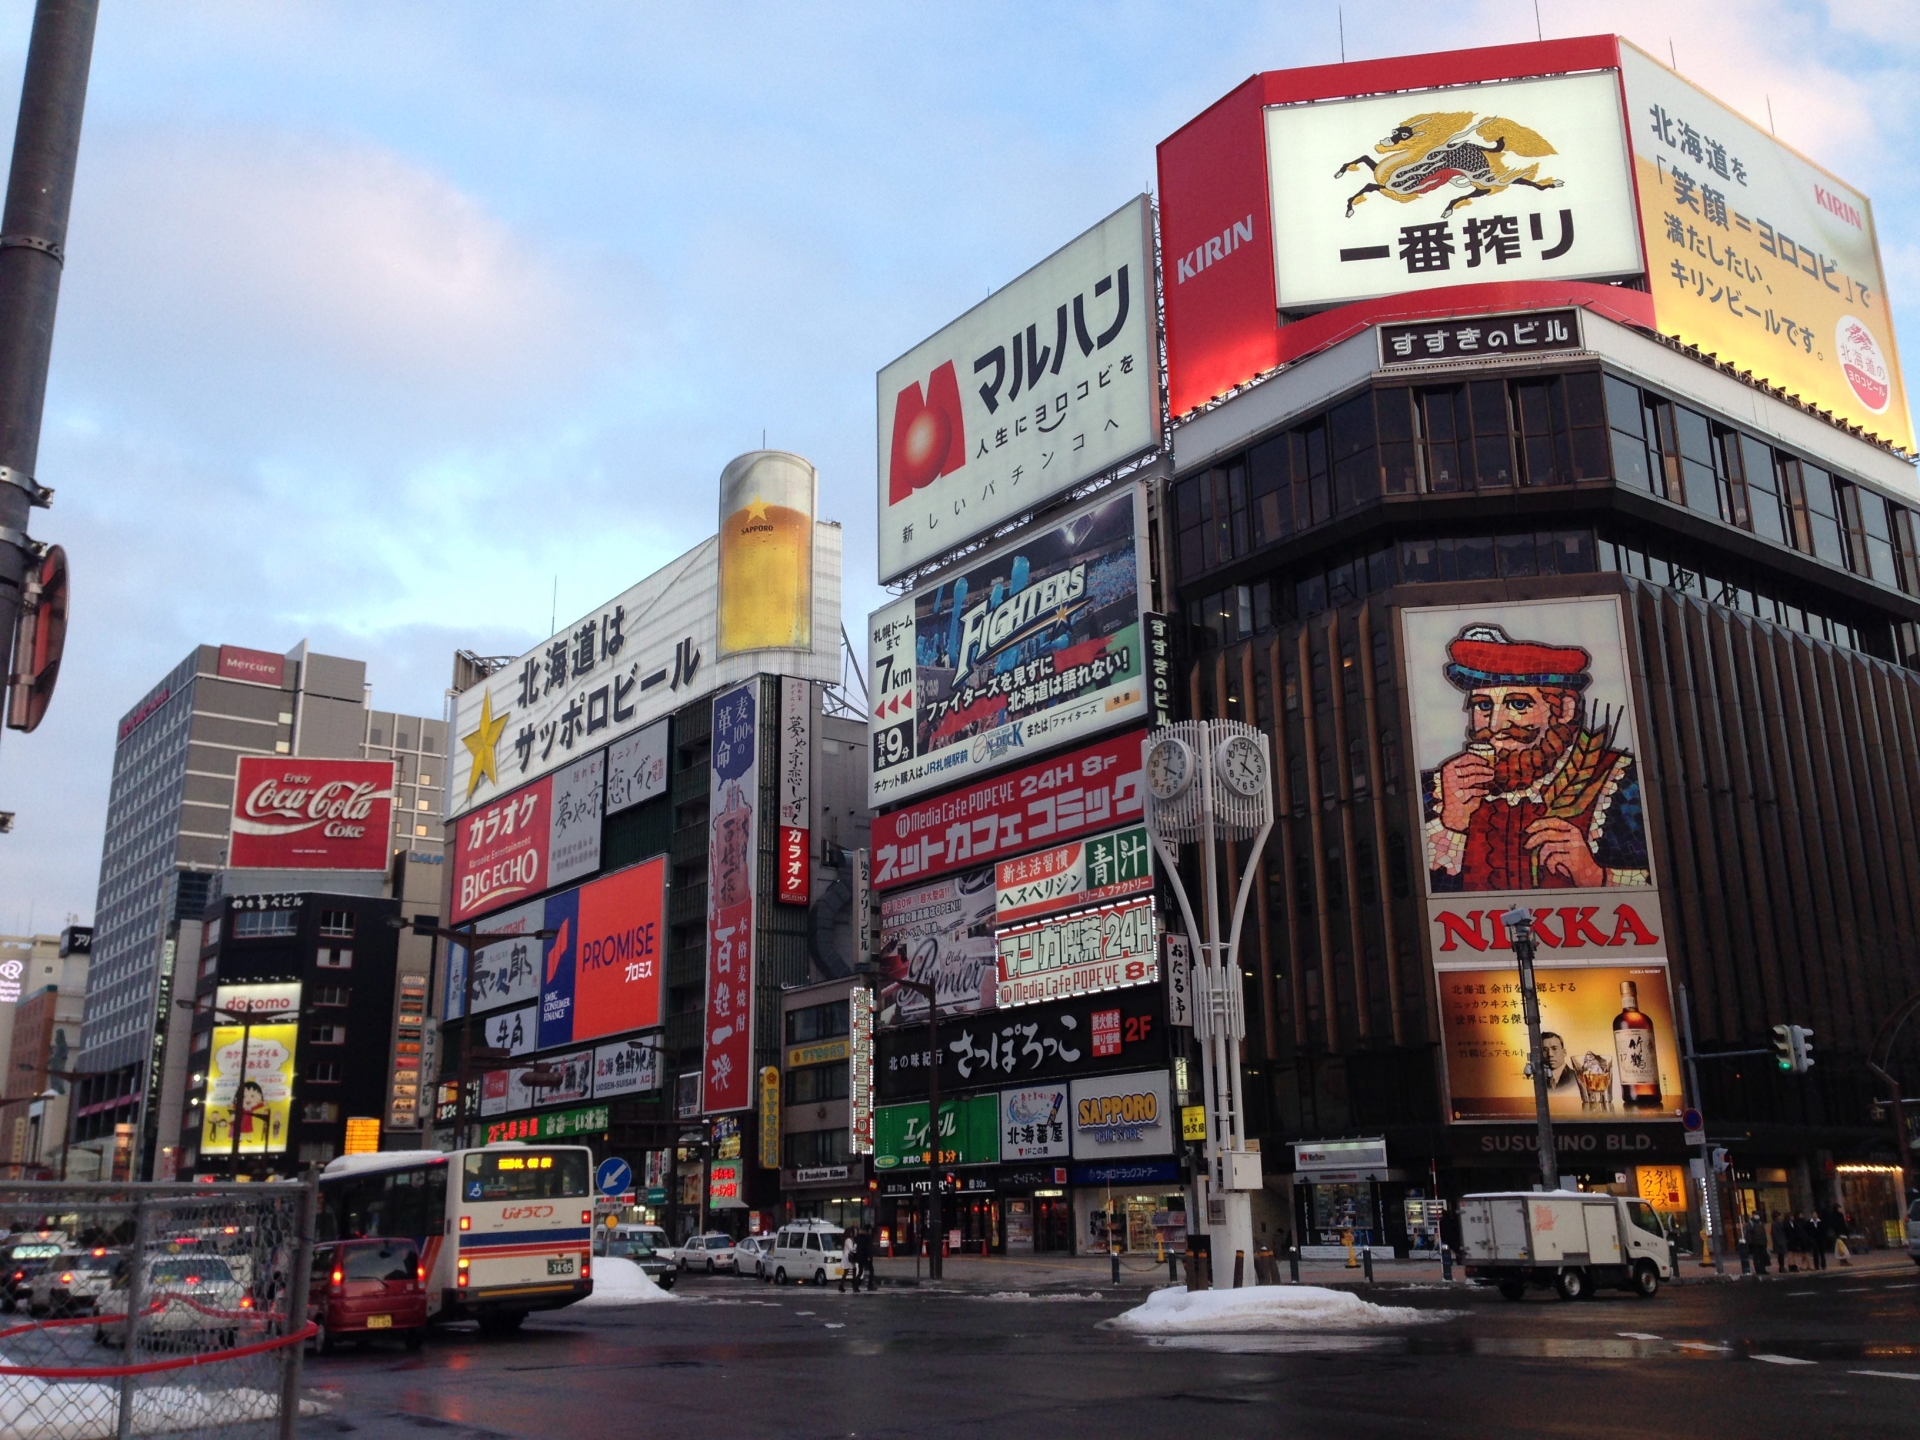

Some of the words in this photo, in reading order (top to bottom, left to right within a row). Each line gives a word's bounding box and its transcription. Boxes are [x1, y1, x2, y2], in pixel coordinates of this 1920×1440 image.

[1650, 104, 1747, 187] 北海道を
[1814, 184, 1862, 231] KIRIN
[1176, 214, 1254, 285] KIRIN
[1340, 209, 1575, 274] 一番搾り
[1664, 211, 1772, 294] 満たしたい、
[1671, 260, 1823, 360] キリンビールです。
[973, 264, 1130, 415] マルハン
[1391, 319, 1569, 356] すすきのビル
[1840, 343, 1886, 381] 北海道の
[1848, 368, 1886, 397] ヨロコビール
[976, 354, 1133, 459] 人生にヨロコビを
[902, 419, 1119, 543] 新しいパチンコへ
[741, 525, 773, 535] SAPPORO
[874, 615, 913, 643] 札幌ドーム
[886, 636, 901, 651] まで
[952, 564, 1087, 688] FIGHTERS
[226, 657, 276, 674] Mercure
[517, 605, 625, 709] 北海道は
[875, 654, 912, 695] 7km
[516, 637, 701, 773] サッポロビール
[926, 656, 1053, 722] ファイターズを見ずに
[1027, 718, 1048, 738] または
[1052, 705, 1097, 728] ファイターズ
[717, 706, 732, 769] 革命
[878, 732, 886, 767] 地下鉄
[283, 773, 311, 784] Enjoy
[911, 807, 940, 833] Media
[943, 798, 967, 822] Cafe
[969, 781, 1014, 814] POPEYE
[1020, 763, 1073, 798] 24H
[1082, 755, 1117, 777] 8F
[245, 779, 377, 821] Coca-Cola
[324, 821, 365, 839] Coke
[468, 793, 537, 851] カラオケ
[874, 768, 1144, 884] ネットカフェコミック
[493, 849, 538, 889] ECHO
[787, 830, 802, 890] カラオケ
[1003, 850, 1068, 884] 新生活習慣
[1088, 843, 1146, 887] 青汁
[1000, 873, 1082, 906] ヘスペリジン
[582, 923, 654, 972] PROMISE
[625, 960, 652, 983] プロミス
[736, 917, 748, 1033] 本格麦焼酎
[1014, 978, 1044, 1001] Media
[1047, 972, 1070, 996] Cafe
[1073, 963, 1120, 994] POPEYE
[1125, 963, 1154, 980] 8F
[1452, 984, 1486, 994] 北海道
[1491, 982, 1576, 993] 余市を郷とする
[543, 998, 570, 1012] CONSUMER
[544, 990, 558, 1002] SMBC
[496, 1013, 523, 1049] 牛角
[543, 1009, 565, 1022] FINANCE
[1125, 1015, 1151, 1042] 2F
[225, 1050, 279, 1059] カケーダイ&
[231, 1061, 270, 1069] パあえる
[855, 1007, 870, 1119] ネットカフェコミック
[950, 1015, 1081, 1079] さっぽろっこ
[596, 1078, 637, 1091] UOSEN-SUISAN
[640, 1075, 650, 1084] 入口
[1079, 1092, 1157, 1126] SAPPORO
[904, 1112, 956, 1149] エイル
[1007, 1122, 1063, 1145] 北海番屋
[1095, 1130, 1114, 1142] DRUG
[1117, 1128, 1143, 1140] STORE
[1481, 1135, 1596, 1151] SUSUINO
[1607, 1134, 1657, 1150] BLD.
[804, 1170, 828, 1180] Susukino
[1654, 1170, 1668, 1206] タイムズ
[1666, 1170, 1678, 1191] 札幌
[502, 1205, 554, 1220] じょうてつ
